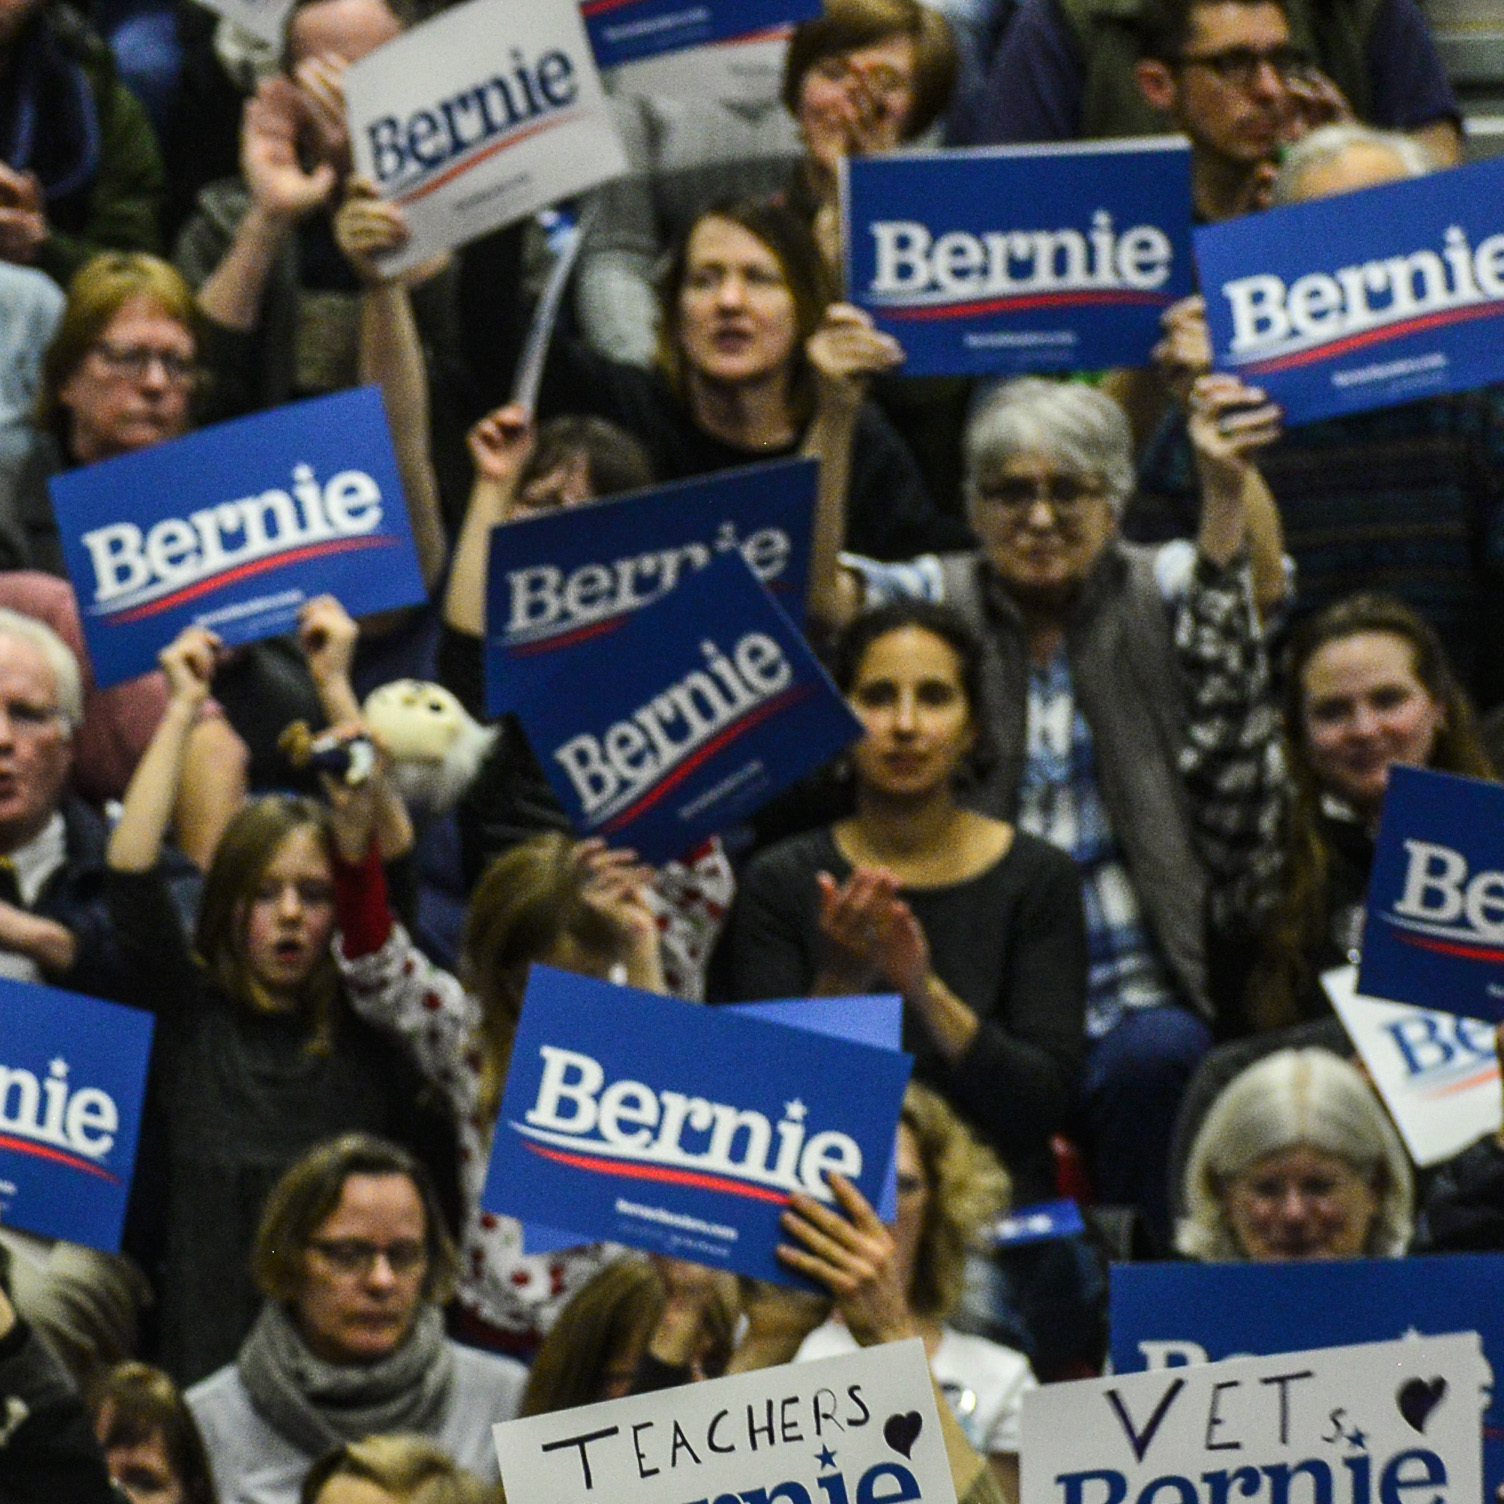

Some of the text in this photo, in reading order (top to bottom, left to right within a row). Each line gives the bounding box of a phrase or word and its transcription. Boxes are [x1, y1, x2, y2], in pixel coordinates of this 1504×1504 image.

[367, 47, 579, 184] Bernie
[870, 211, 1173, 292] Bernie
[81, 462, 385, 600] Bernie
[554, 632, 791, 813] Bernie
[525, 1044, 863, 1200] Bernie
[542, 1384, 870, 1489] TEACHERS
